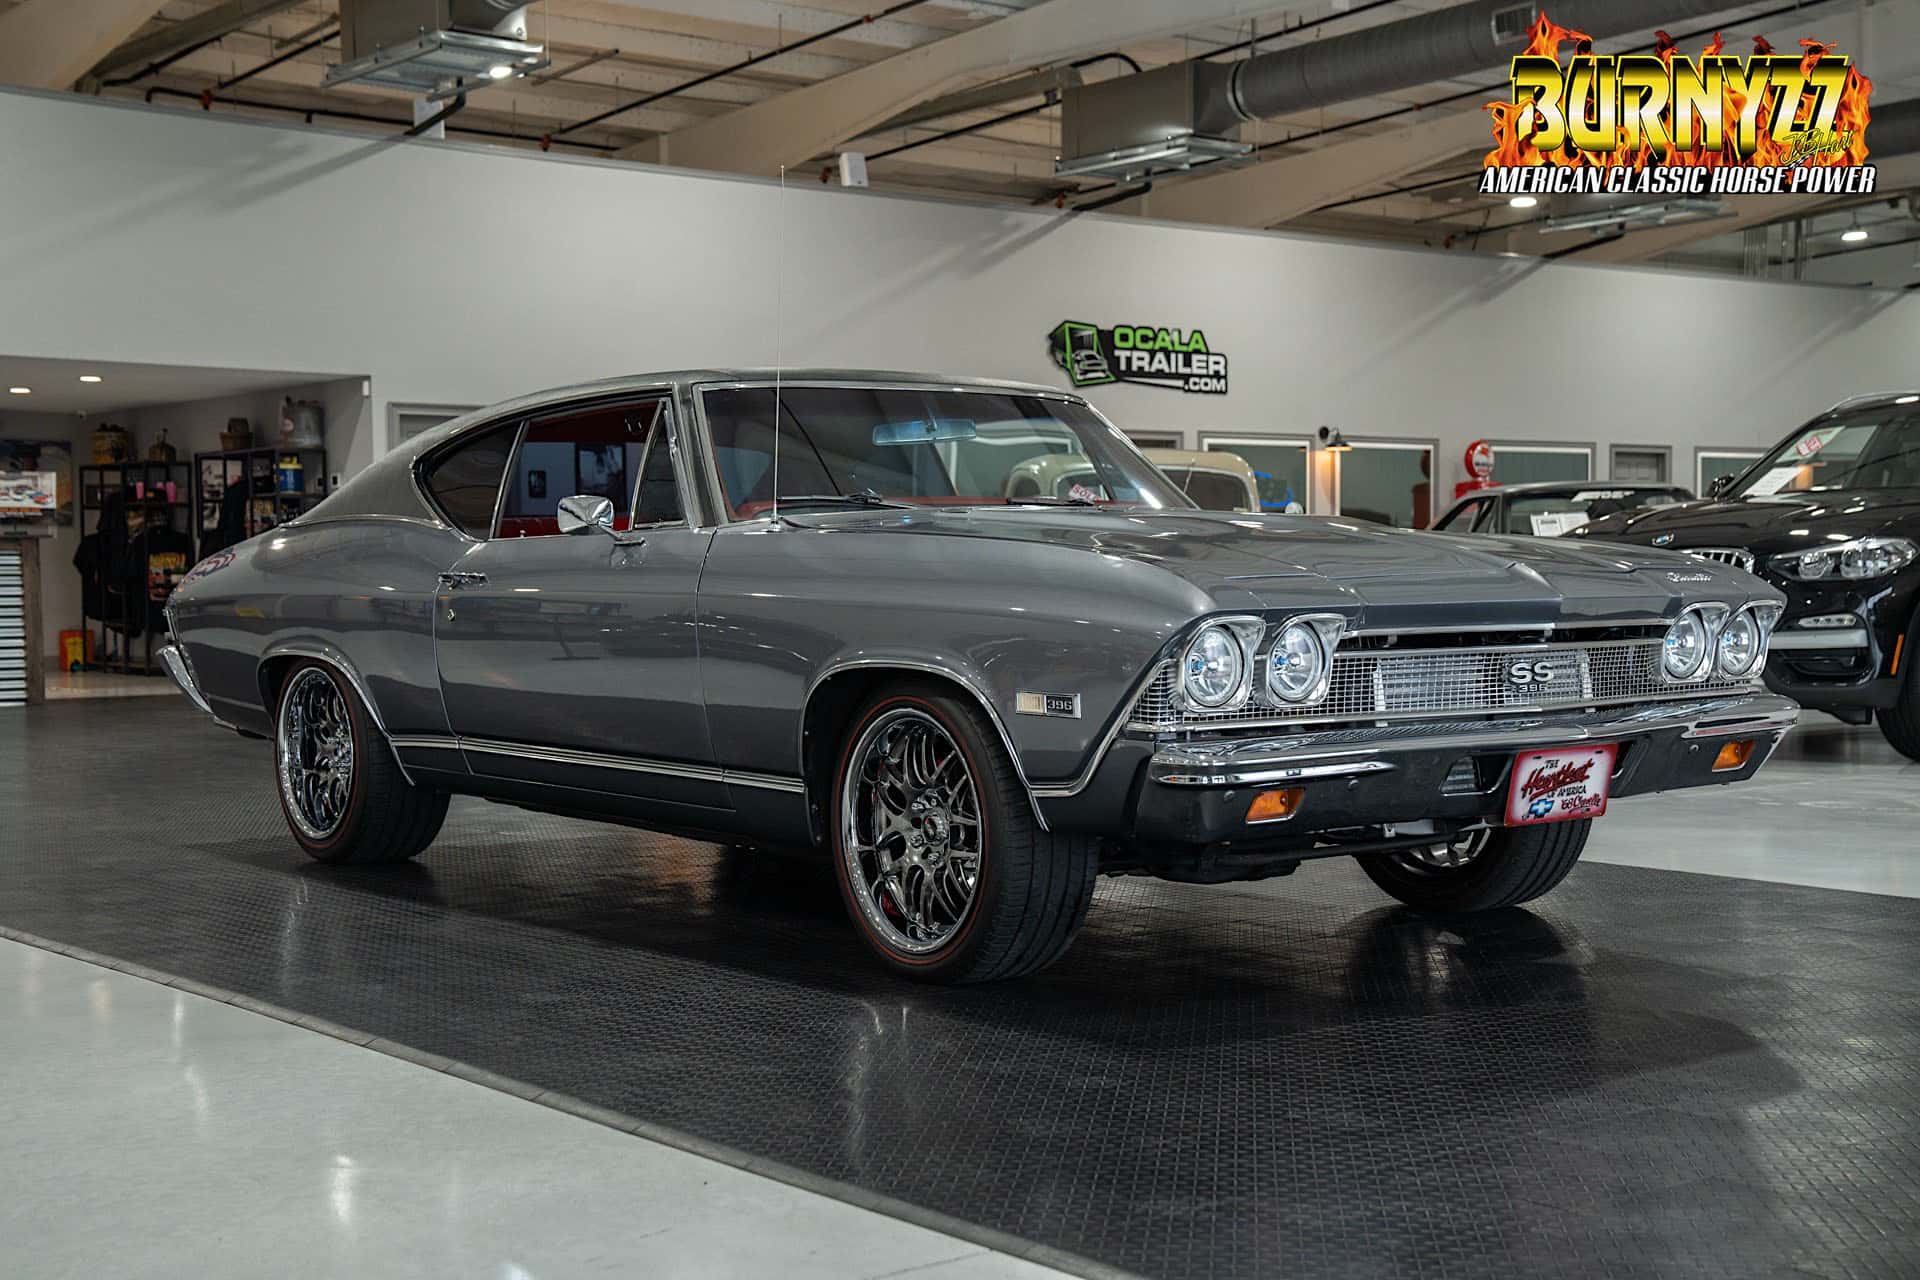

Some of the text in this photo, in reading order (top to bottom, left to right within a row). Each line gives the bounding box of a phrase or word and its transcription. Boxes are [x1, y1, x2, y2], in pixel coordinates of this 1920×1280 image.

[1113, 326, 1207, 353] OCALA
[1113, 350, 1227, 376] TRAILER
[1184, 377, 1226, 392] .COM
[1510, 661, 1554, 684] SS
[1047, 699, 1073, 711] 396
[1556, 784, 1587, 798] AMERICA
